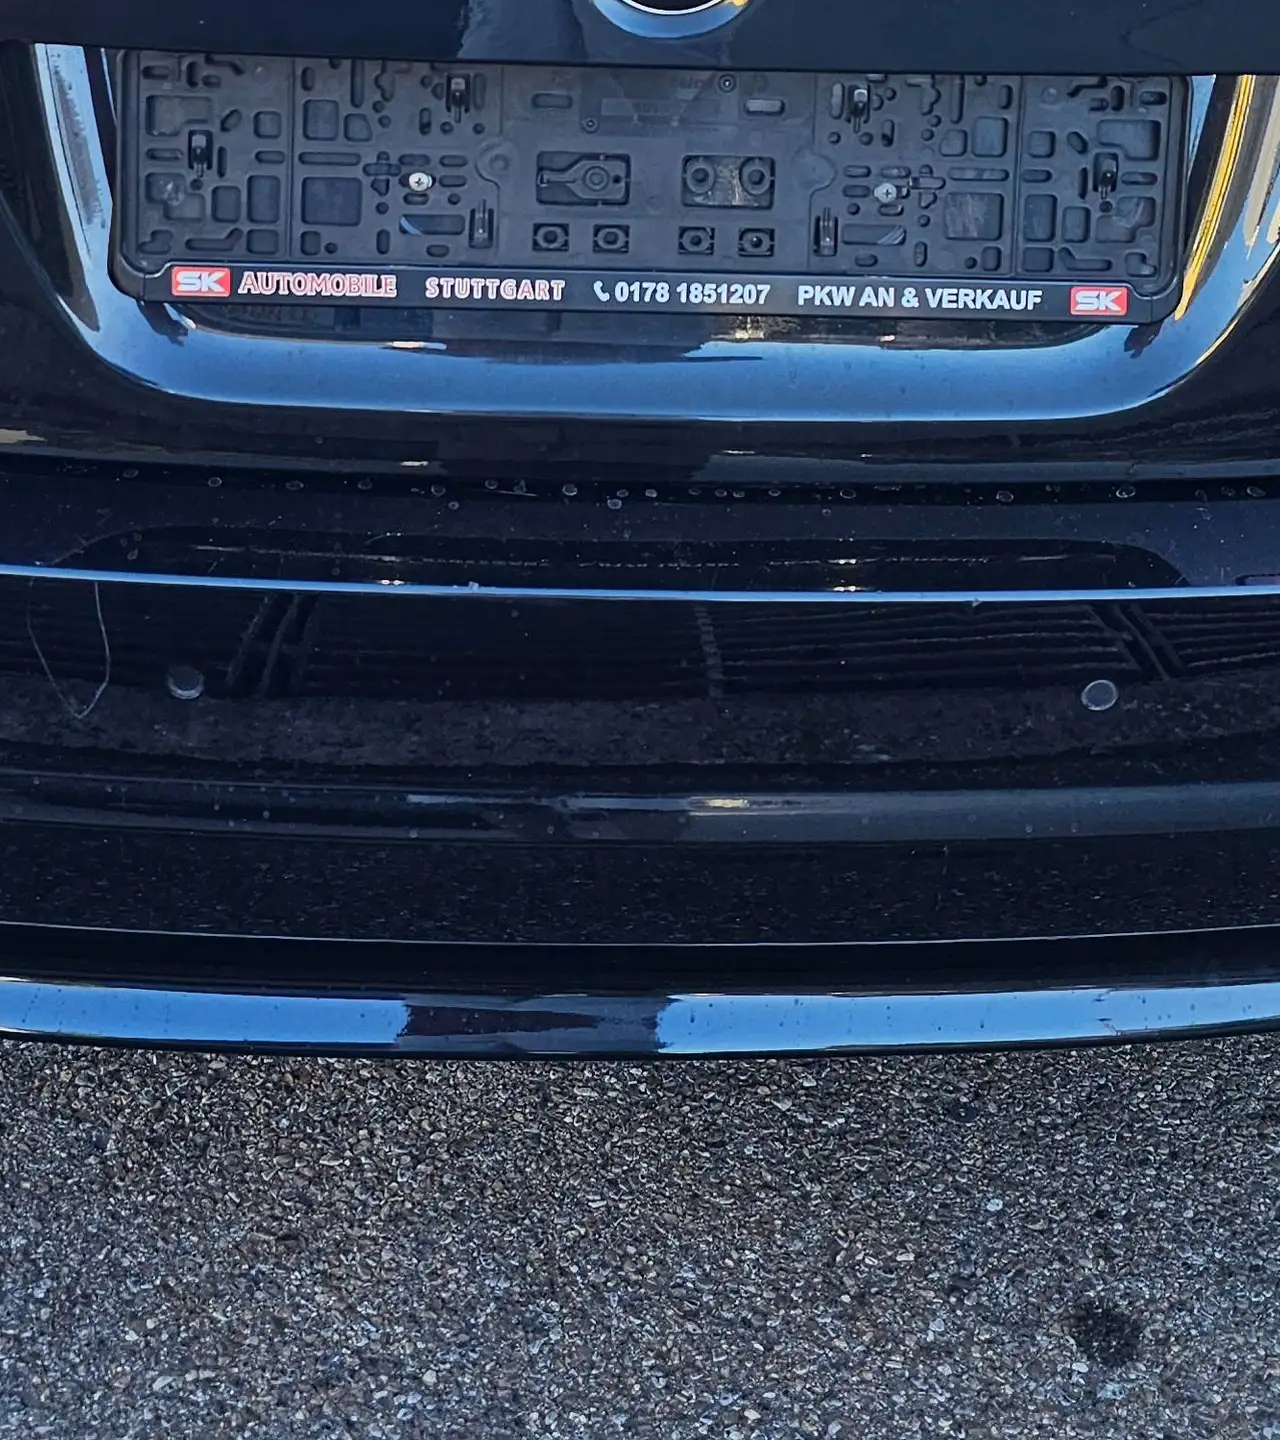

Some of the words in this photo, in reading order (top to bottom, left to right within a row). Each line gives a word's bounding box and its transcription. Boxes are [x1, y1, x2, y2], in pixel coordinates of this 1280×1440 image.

[175, 270, 226, 293] SK
[238, 271, 397, 297] AUTOMOBILE
[425, 276, 566, 301] STUTTGART
[614, 281, 670, 304] 0178
[675, 283, 771, 305] 1851207
[797, 285, 854, 306] PKW
[858, 286, 895, 307] AN
[901, 287, 920, 308] &
[926, 288, 1043, 311] VERKAUF
[1074, 290, 1123, 312] SK
